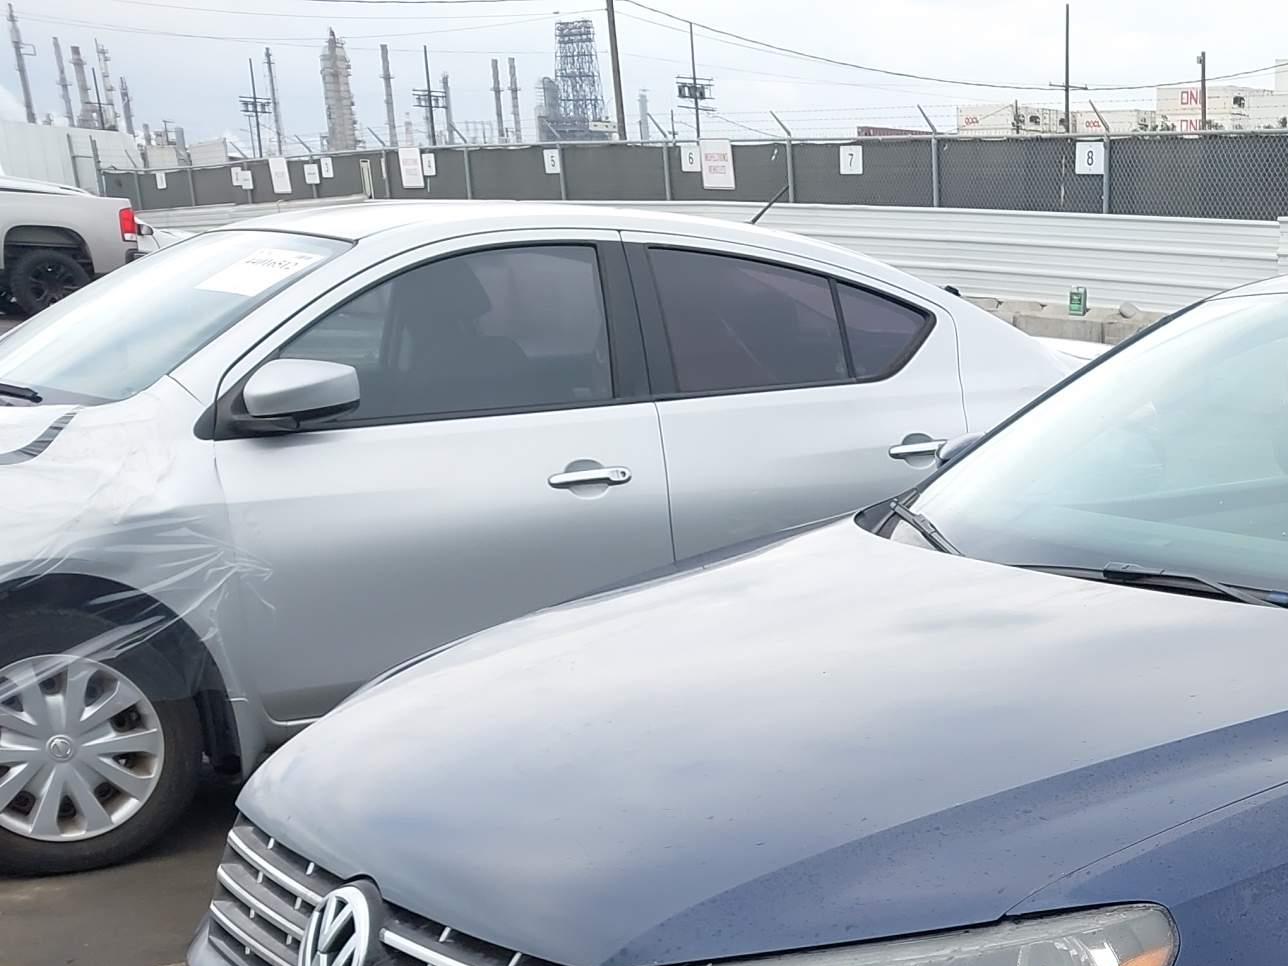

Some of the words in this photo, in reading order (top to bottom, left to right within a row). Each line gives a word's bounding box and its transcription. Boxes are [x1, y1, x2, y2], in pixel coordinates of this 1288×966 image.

[1180, 89, 1202, 105] ON
[550, 155, 556, 168] 5
[688, 152, 694, 165] 6
[848, 153, 854, 167] 7
[1086, 150, 1094, 166] 8
